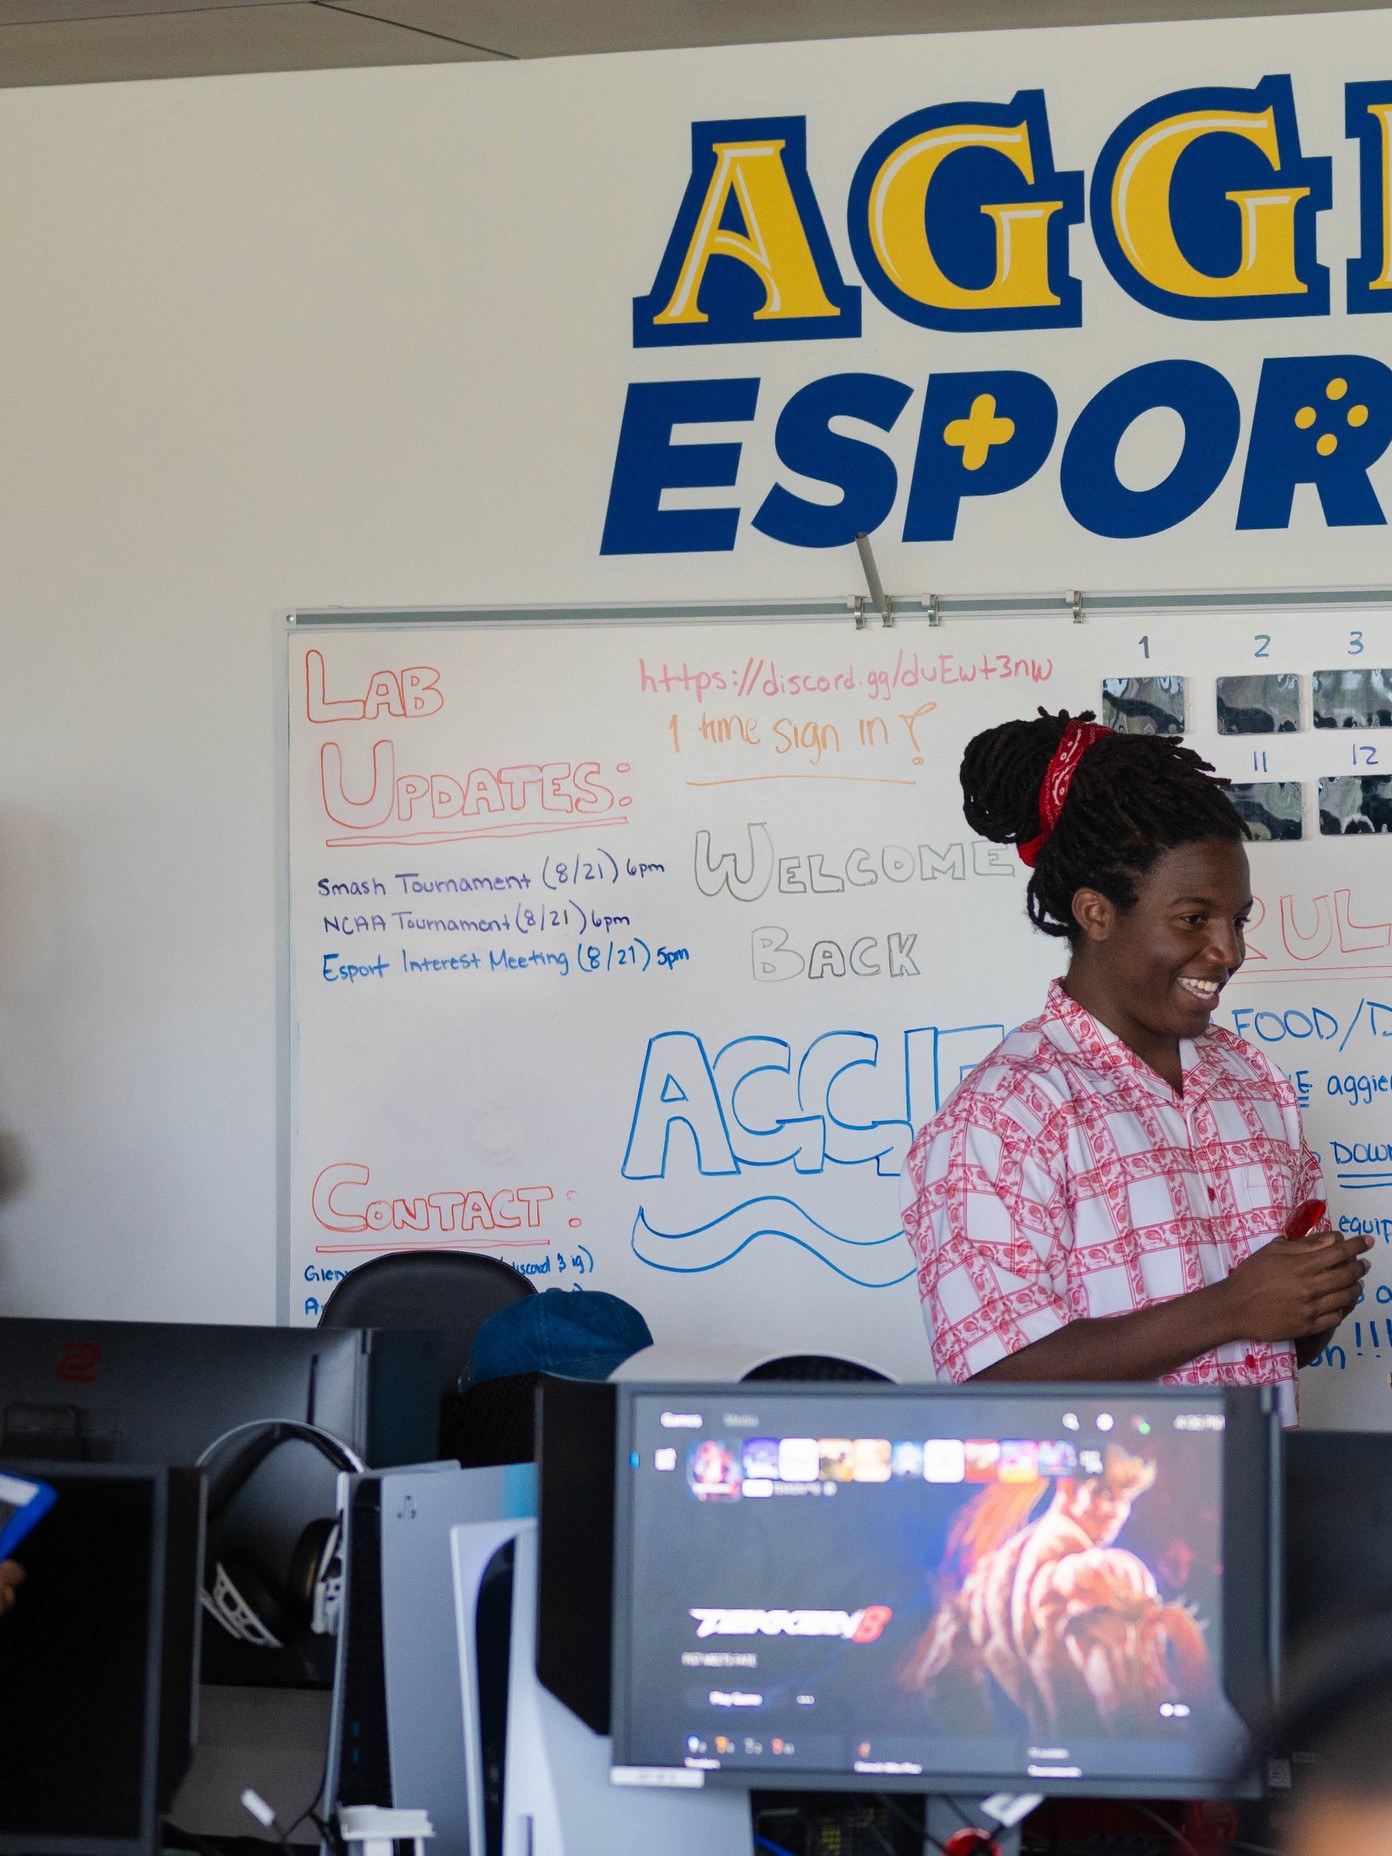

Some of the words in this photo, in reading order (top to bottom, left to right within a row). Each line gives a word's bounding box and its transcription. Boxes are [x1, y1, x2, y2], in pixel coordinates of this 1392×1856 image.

[1138, 635, 1150, 659] 1
[1253, 635, 1272, 658] 2
[1347, 631, 1365, 655] 3
[669, 714, 680, 753] 1
[698, 712, 761, 745] time
[860, 717, 888, 746] in
[1253, 751, 1268, 773] 11
[1352, 743, 1379, 766] 12
[319, 739, 634, 830] UPDATES:
[317, 877, 386, 897] Smash
[394, 872, 532, 895] Tournament
[542, 847, 619, 890] (8/21)
[626, 858, 665, 875] 6pm
[694, 822, 1017, 902] WELCOME
[323, 915, 387, 935] NCAA
[391, 910, 511, 932] Tournament
[515, 899, 588, 936] (8/21)
[591, 914, 631, 935] 6pm
[322, 952, 391, 984] Esport
[401, 949, 481, 973] Interest
[489, 950, 570, 977] Meeting
[577, 937, 651, 973] (8/21)
[656, 946, 690, 966] 5pm
[751, 926, 921, 981] BACK
[312, 1163, 584, 1234] CONTACT:
[304, 1264, 350, 1281] Glen
